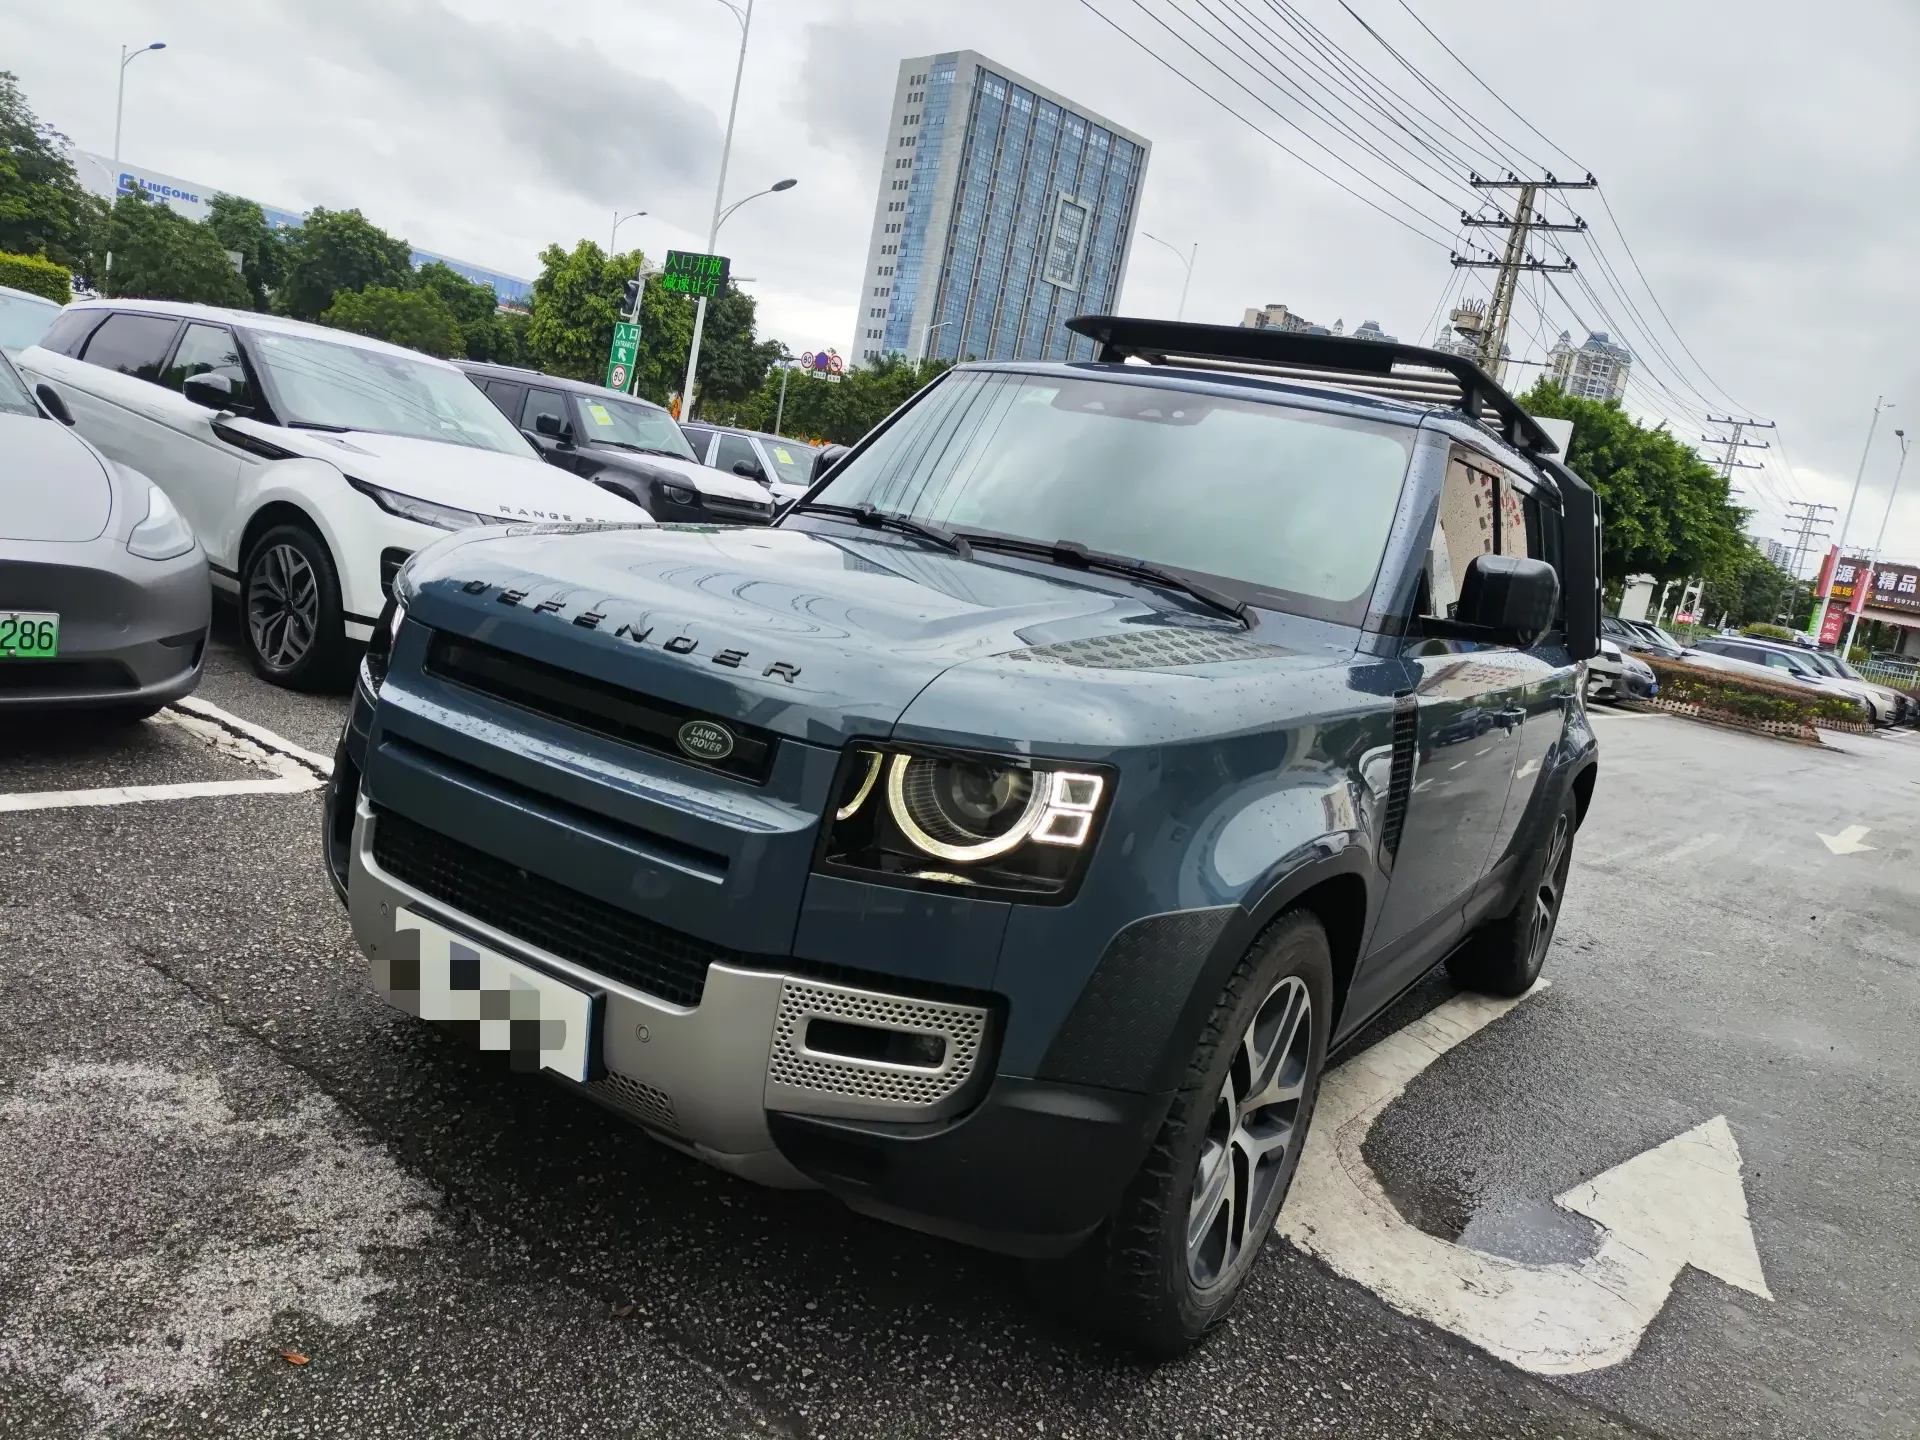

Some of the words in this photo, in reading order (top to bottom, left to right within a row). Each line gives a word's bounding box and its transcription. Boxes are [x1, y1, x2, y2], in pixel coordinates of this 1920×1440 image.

[665, 251, 722, 275] 入口开放
[663, 272, 719, 297] 减速让行
[617, 324, 638, 340] 入口
[803, 355, 812, 364] 80
[613, 371, 624, 382] 80
[499, 505, 572, 522] RANGE
[0, 619, 54, 651] 286
[461, 579, 803, 684] DEFENDER
